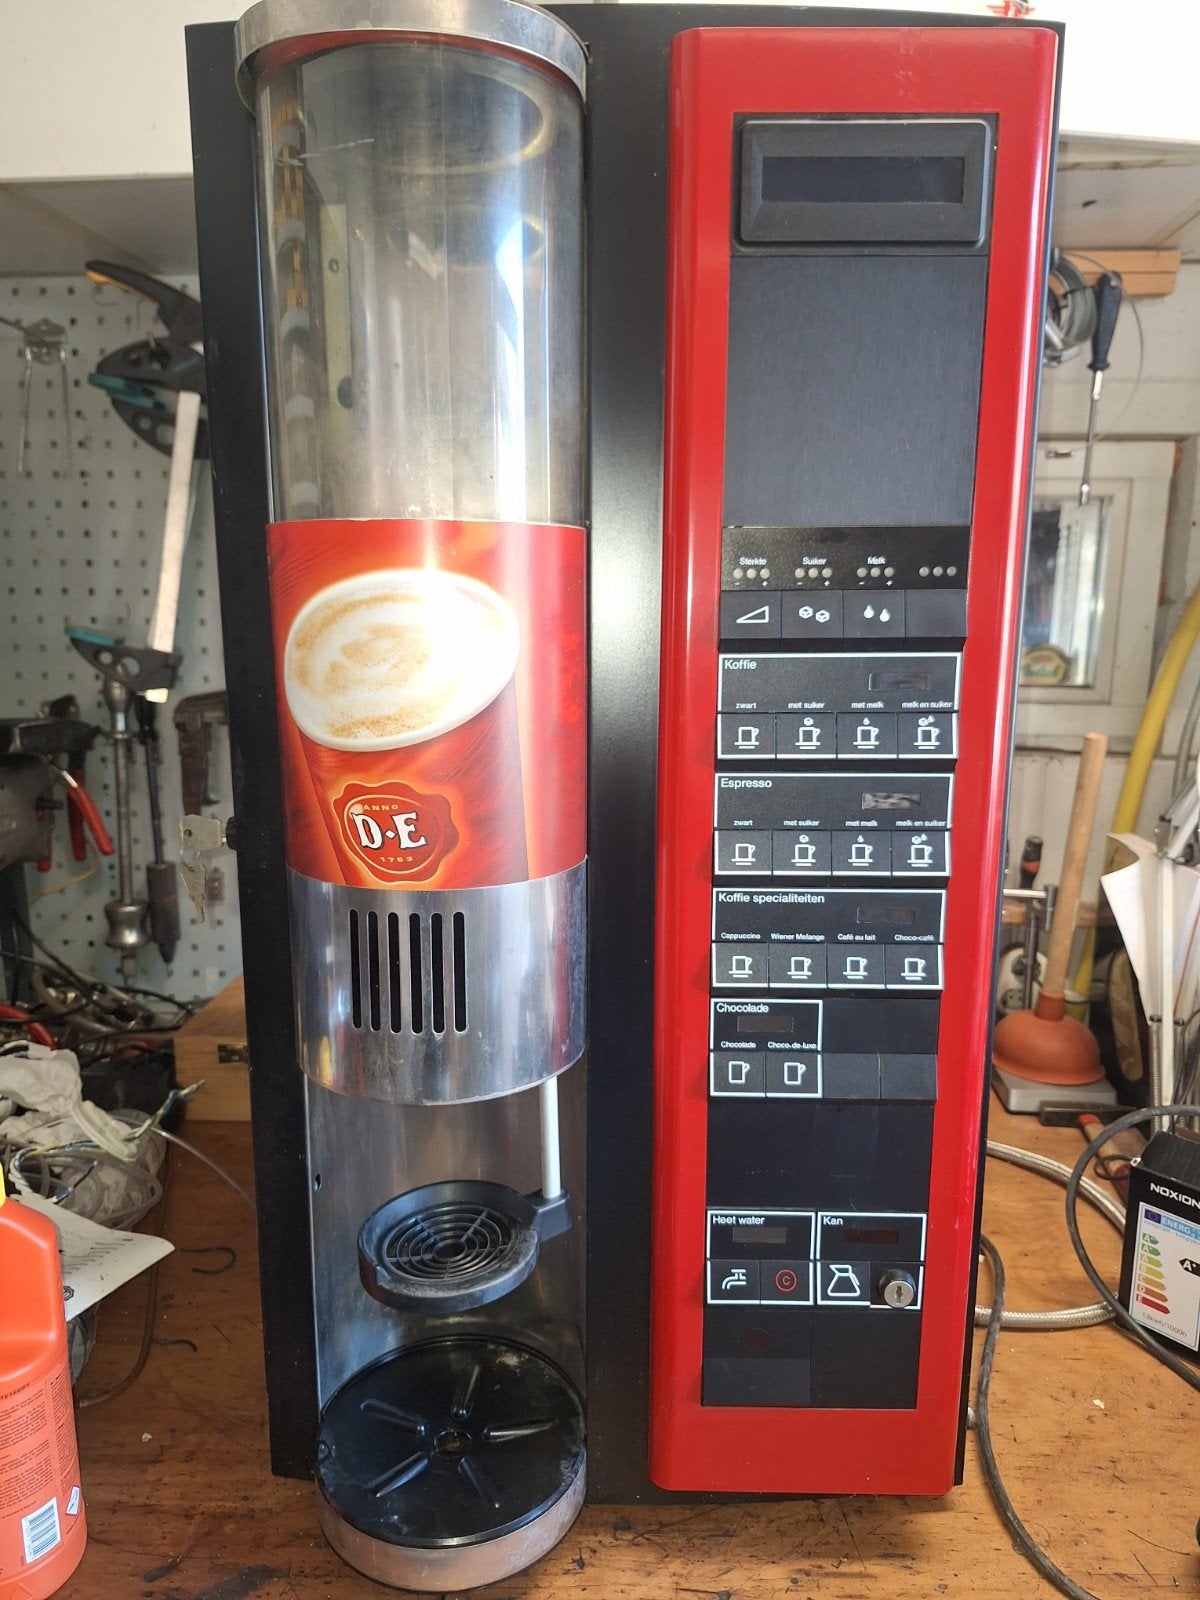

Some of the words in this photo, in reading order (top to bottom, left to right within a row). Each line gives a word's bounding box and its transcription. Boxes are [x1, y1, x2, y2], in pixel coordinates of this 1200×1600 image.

[739, 557, 767, 566] Sterkte
[802, 557, 827, 566] Suiker
[867, 556, 886, 565] Melk
[724, 659, 757, 669] Koffie
[720, 778, 772, 790] Espresso
[718, 892, 750, 903] Koffie
[752, 892, 825, 904] specialiteiten
[721, 932, 761, 940] Cappuccino
[795, 933, 825, 941] Melange
[716, 1003, 769, 1013] Chocolade
[712, 1215, 736, 1225] Heet
[738, 1215, 765, 1225] water
[823, 1216, 843, 1225] Kan
[1182, 1259, 1197, 1271] A+
